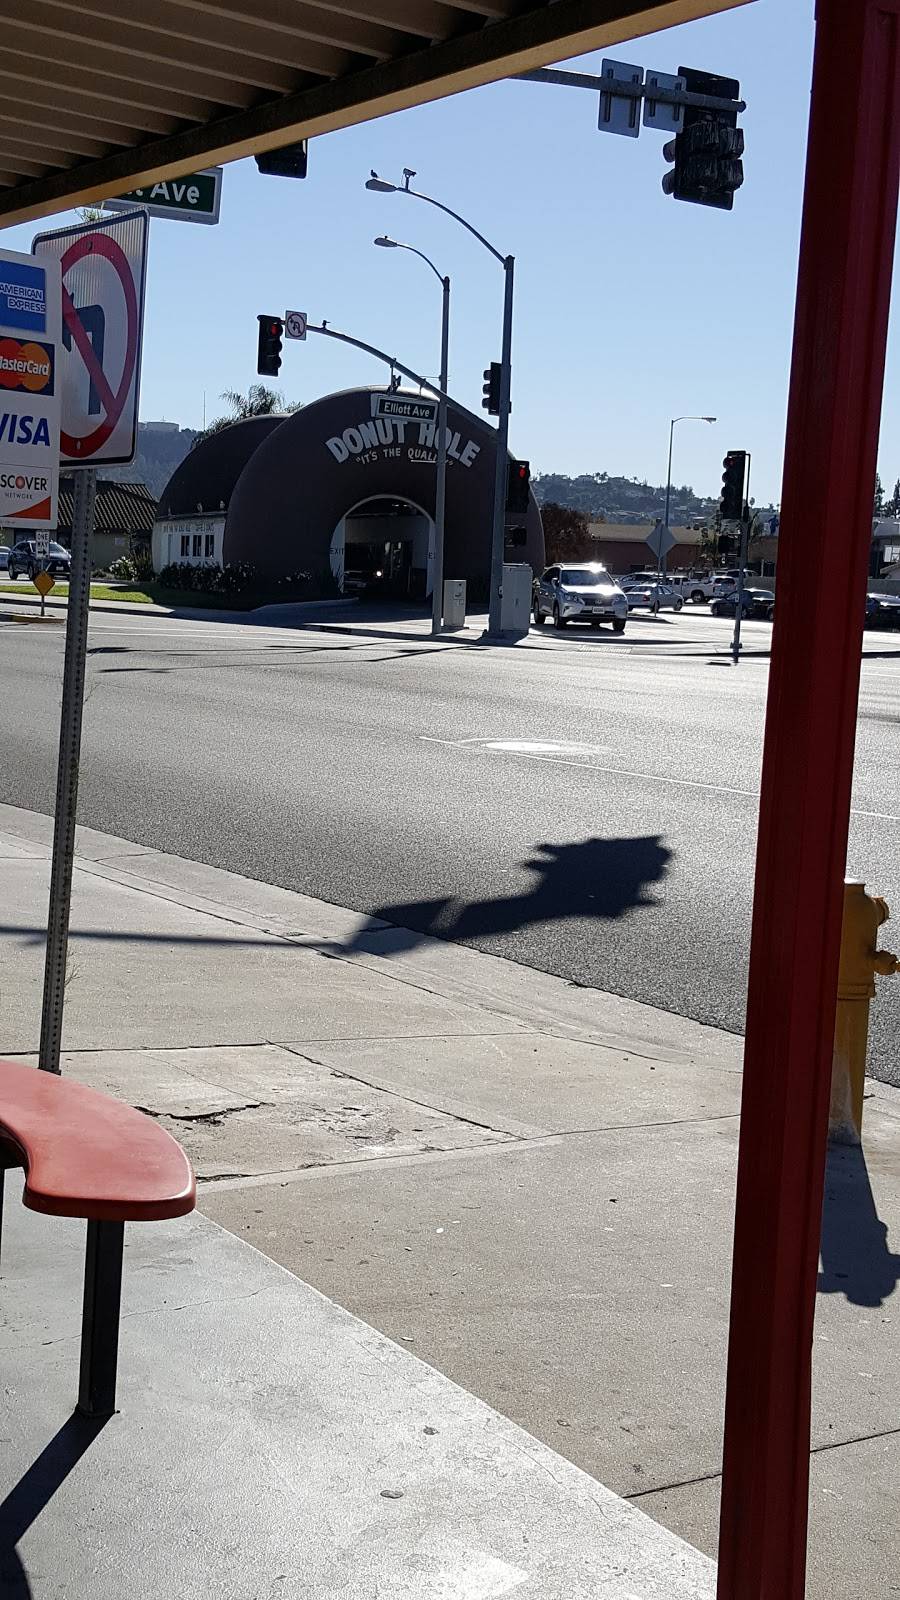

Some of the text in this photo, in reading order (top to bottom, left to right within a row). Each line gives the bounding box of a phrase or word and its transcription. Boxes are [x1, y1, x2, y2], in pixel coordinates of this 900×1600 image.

[150, 181, 200, 204] Ave
[0, 284, 42, 299] AMERICAN
[9, 299, 46, 312] EXPRESS
[384, 402, 430, 418] Elliott Ave
[325, 419, 481, 468] DONUT HOLE
[383, 448, 400, 458] THE
[0, 474, 48, 491] SCOVER
[5, 491, 33, 500] NETWORK
